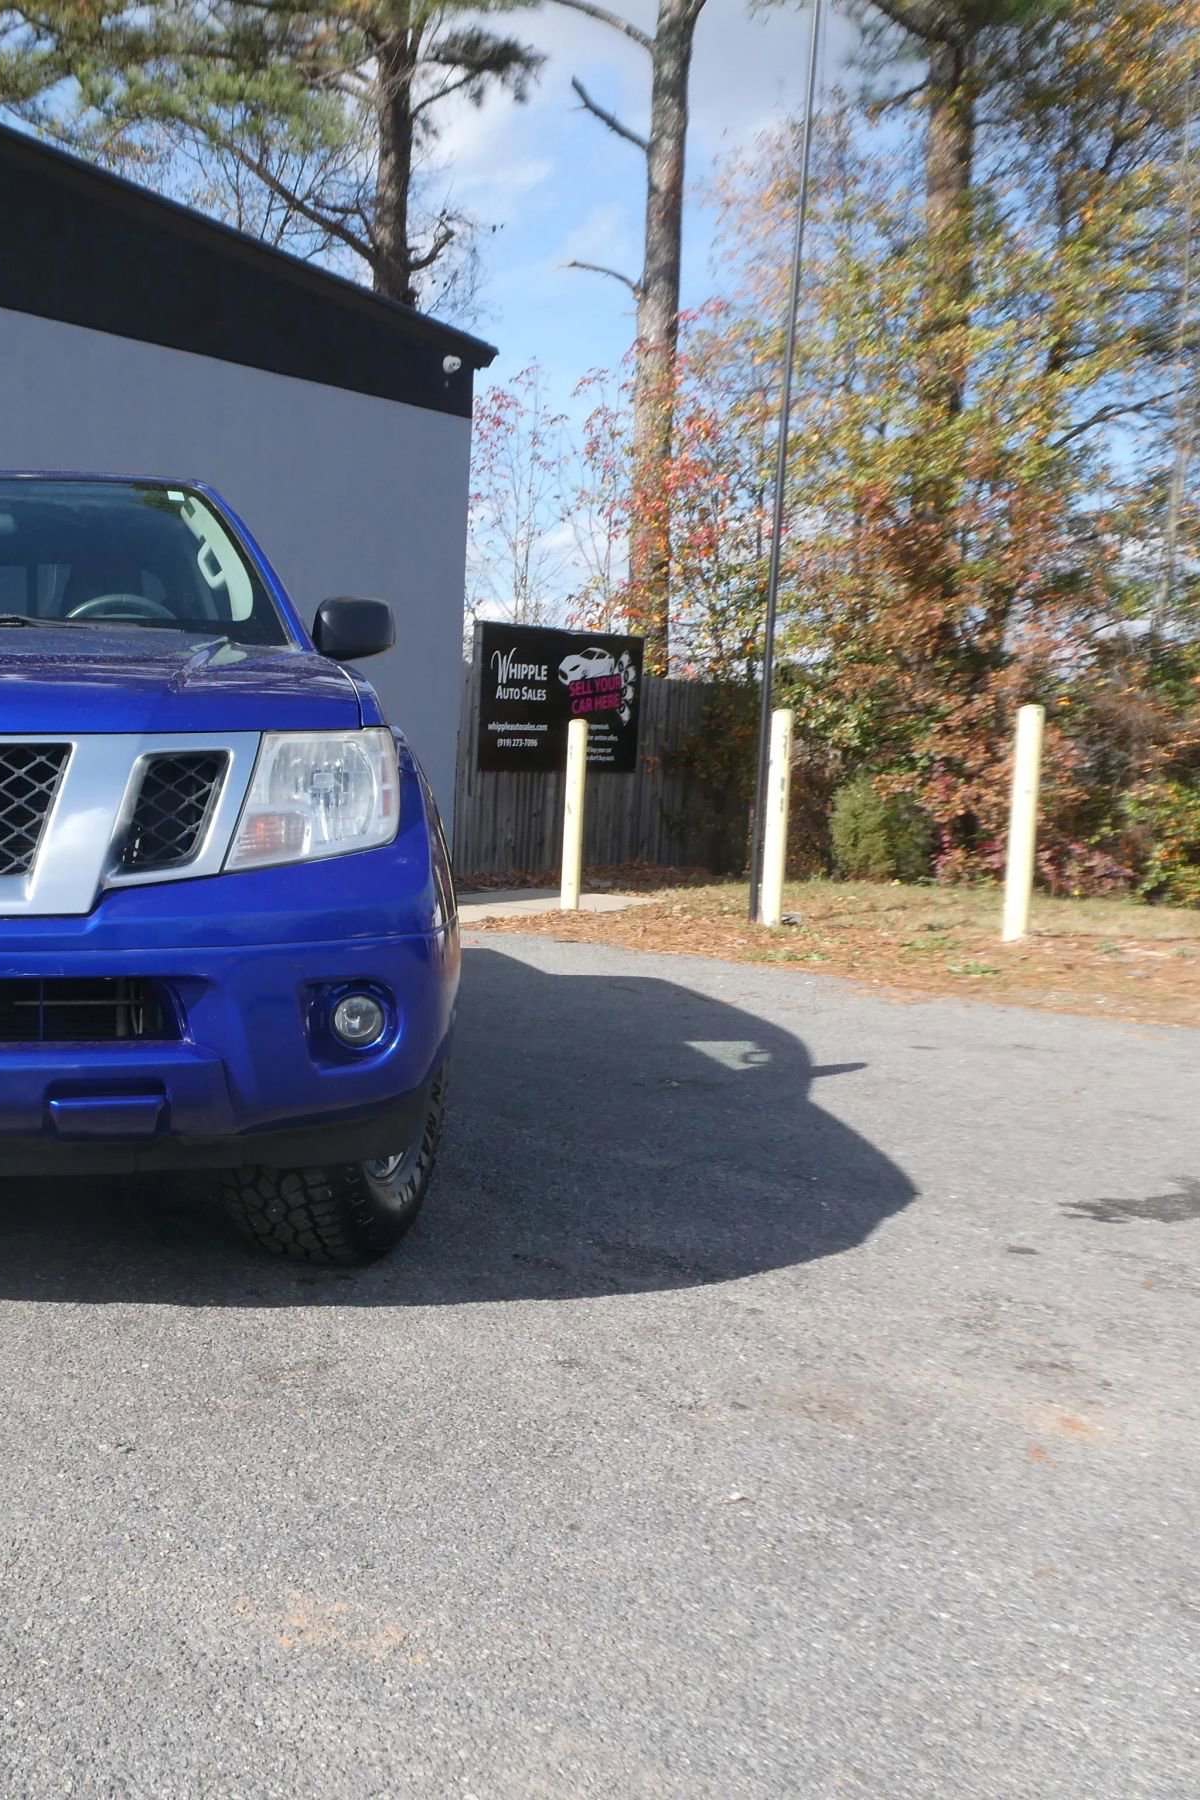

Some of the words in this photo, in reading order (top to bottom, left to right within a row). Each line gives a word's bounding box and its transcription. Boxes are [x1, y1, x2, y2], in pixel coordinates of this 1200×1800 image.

[490, 647, 548, 684] WHIPPLE
[495, 685, 520, 700] AUTO
[521, 686, 547, 701] SALES
[569, 680, 593, 697] SELL
[595, 675, 622, 693] YOUR
[571, 697, 593, 714] CAR
[595, 694, 621, 711] HERE
[487, 721, 548, 733] whippleautosales.com
[497, 738, 511, 748] (919)
[512, 738, 538, 747] 273-7096
